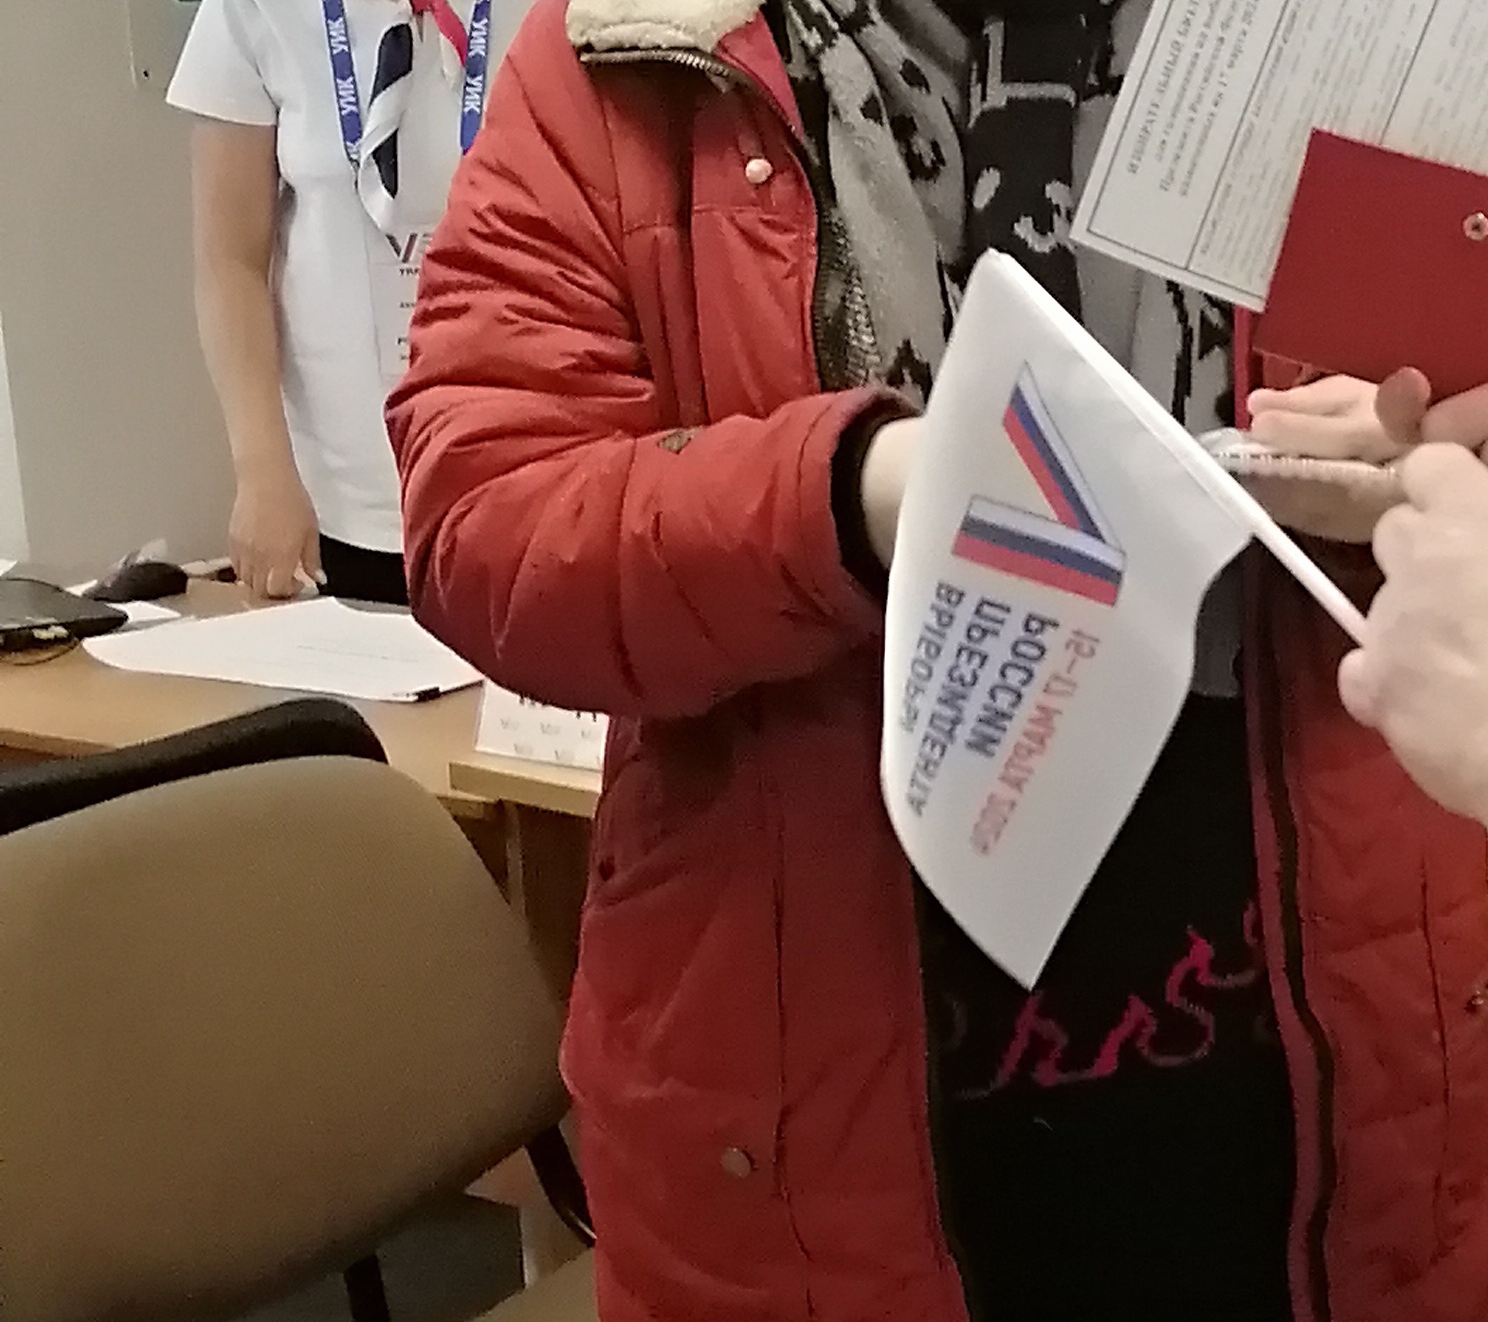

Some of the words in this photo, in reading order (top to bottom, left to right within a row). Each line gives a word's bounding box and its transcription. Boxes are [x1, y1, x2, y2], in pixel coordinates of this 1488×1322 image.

[327, 17, 349, 56] УИК
[469, 18, 488, 58] УИК
[336, 76, 359, 117] УИК
[463, 74, 483, 115] УИК
